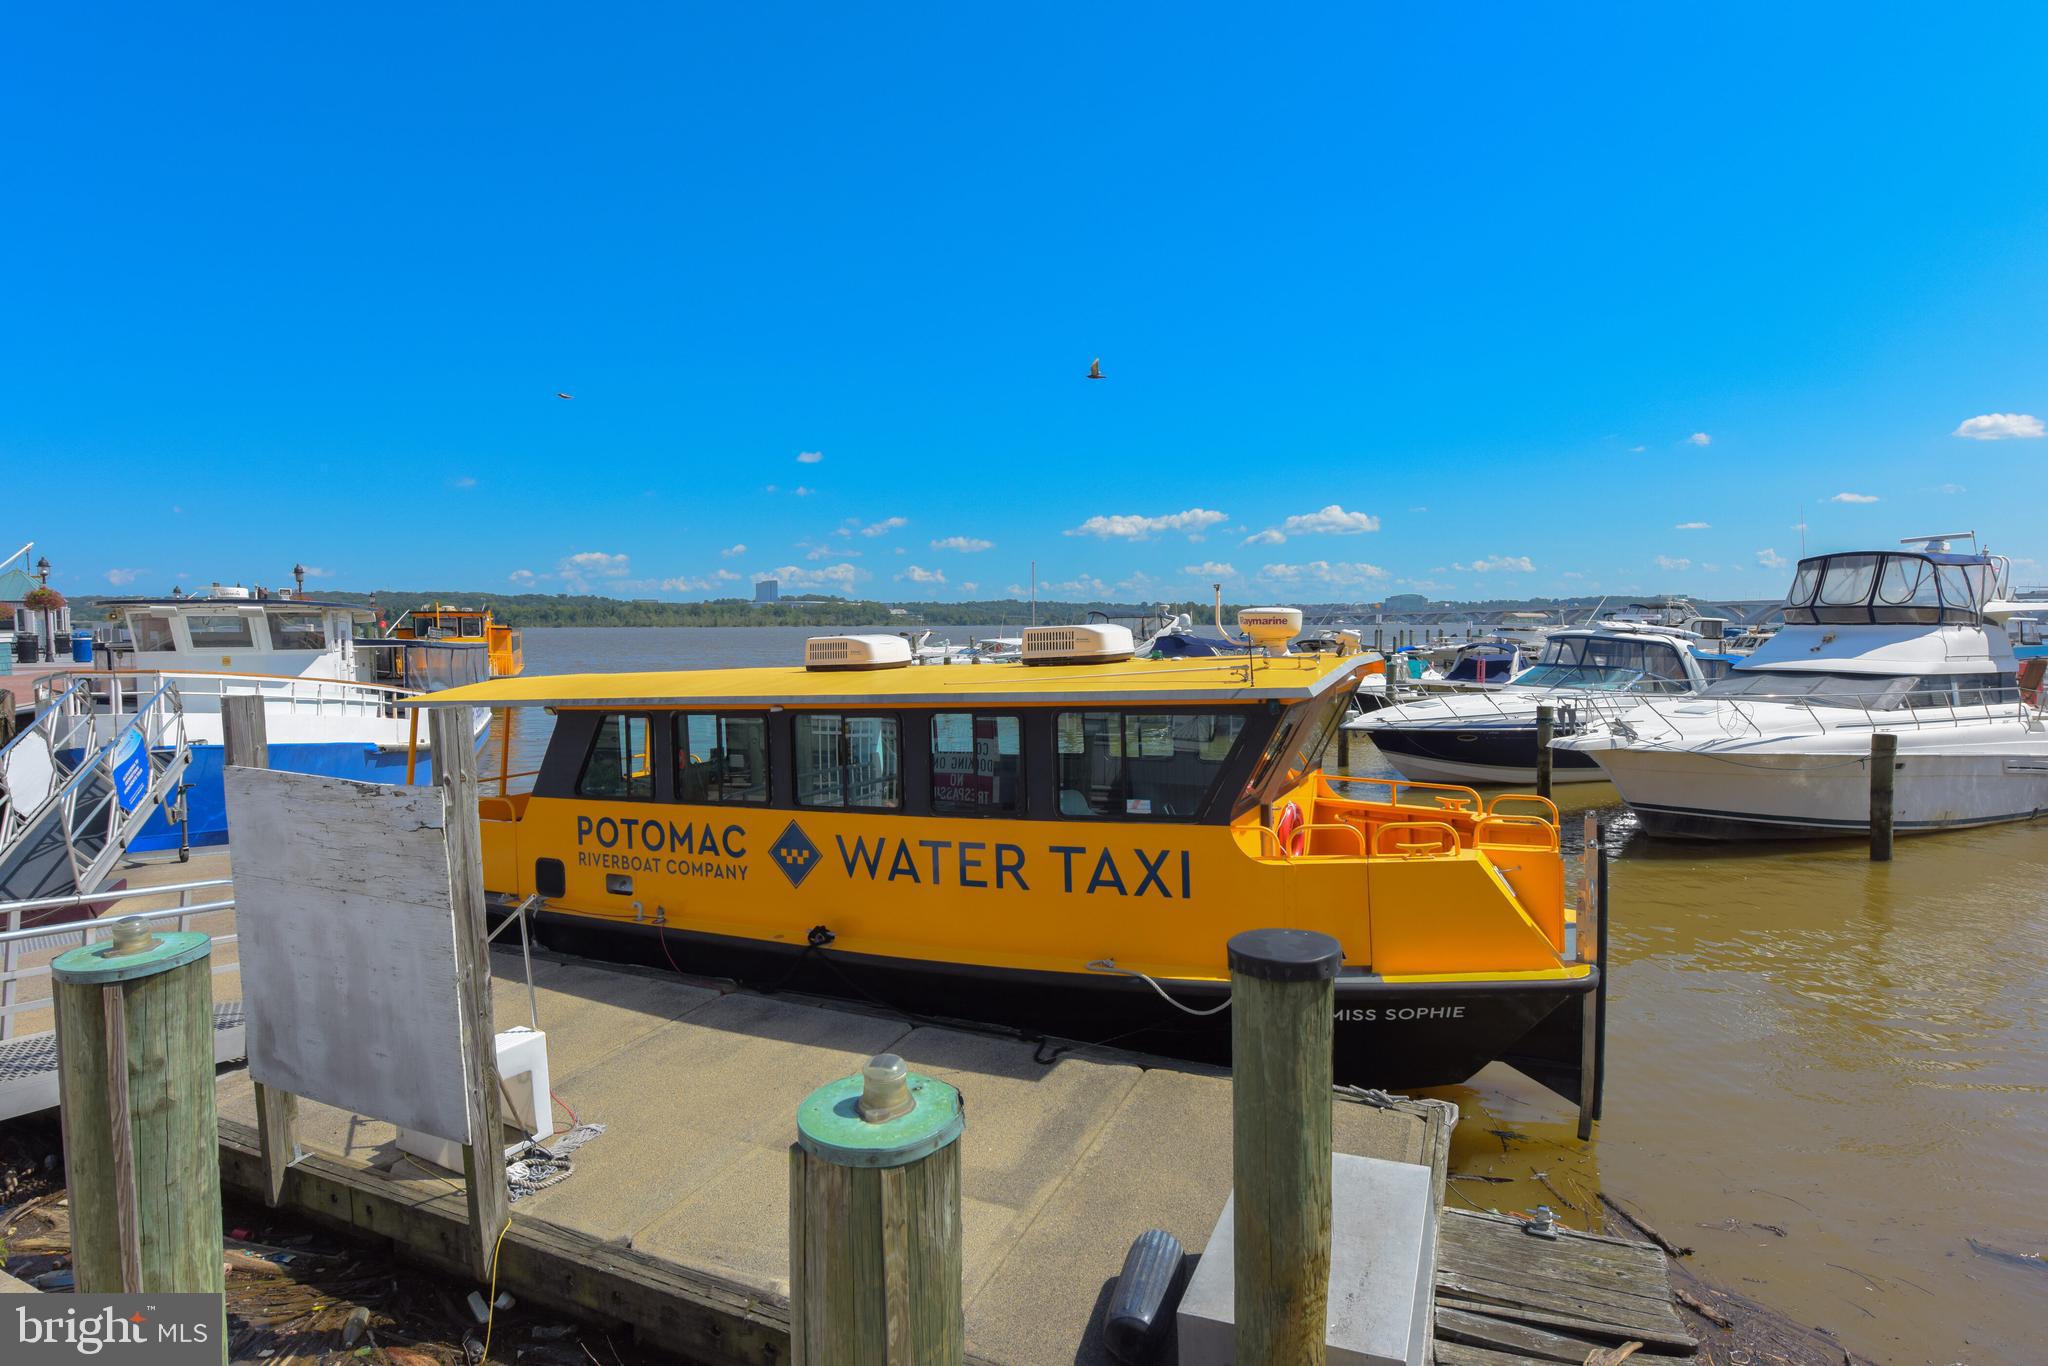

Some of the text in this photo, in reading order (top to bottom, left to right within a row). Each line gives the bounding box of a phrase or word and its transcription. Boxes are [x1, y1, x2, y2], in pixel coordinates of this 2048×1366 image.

[1240, 616, 1288, 627] Raymarine
[577, 815, 746, 858] POTOMAC
[578, 851, 748, 881] RIVERBOAT COMPANY
[835, 834, 1191, 899] WATER TAXI
[1385, 1006, 1465, 1020] SOPHIE
